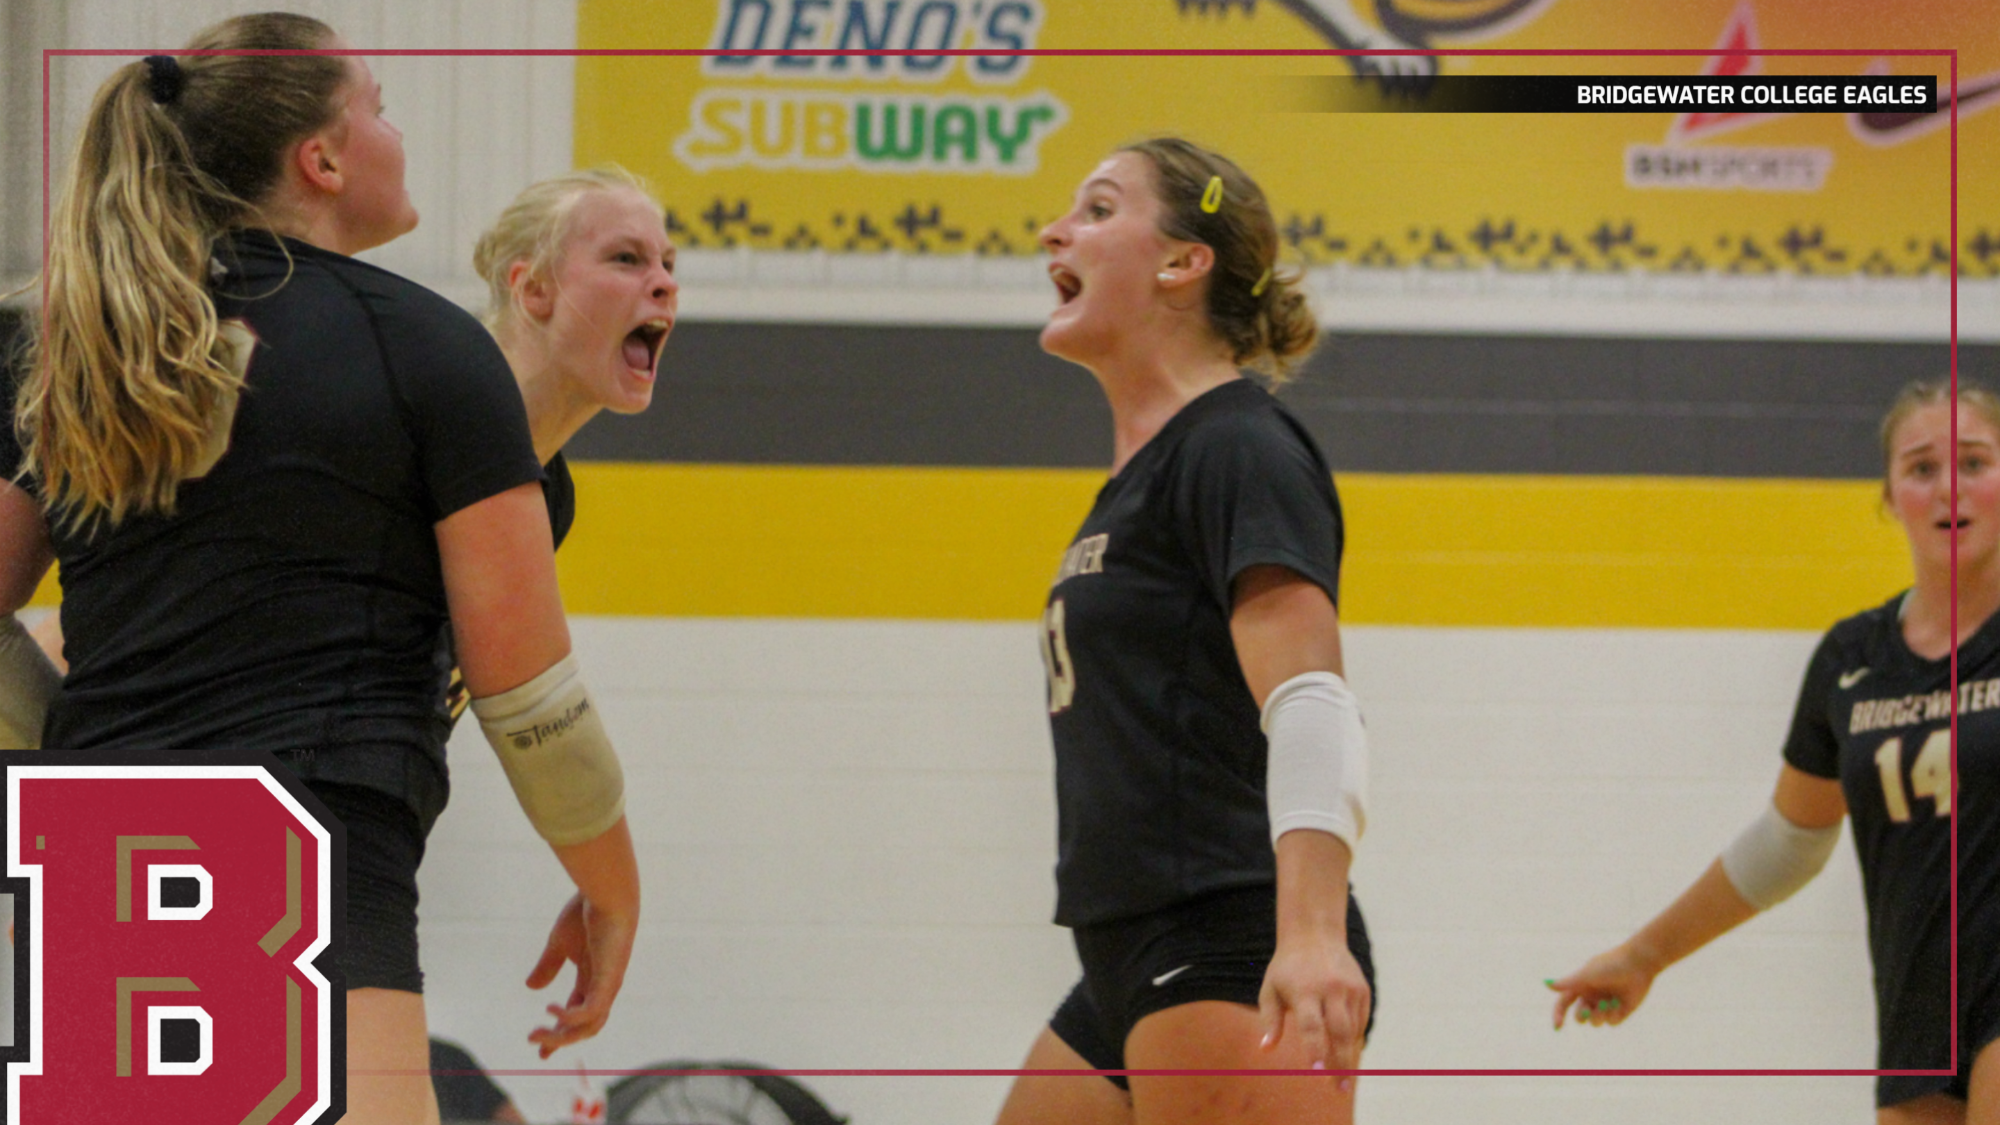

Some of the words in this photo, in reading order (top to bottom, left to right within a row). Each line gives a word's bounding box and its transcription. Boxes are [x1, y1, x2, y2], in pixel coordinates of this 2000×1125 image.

[713, 0, 1034, 74] DENO'S
[686, 98, 1056, 163] SUBWAY
[1874, 728, 1959, 823] 14
